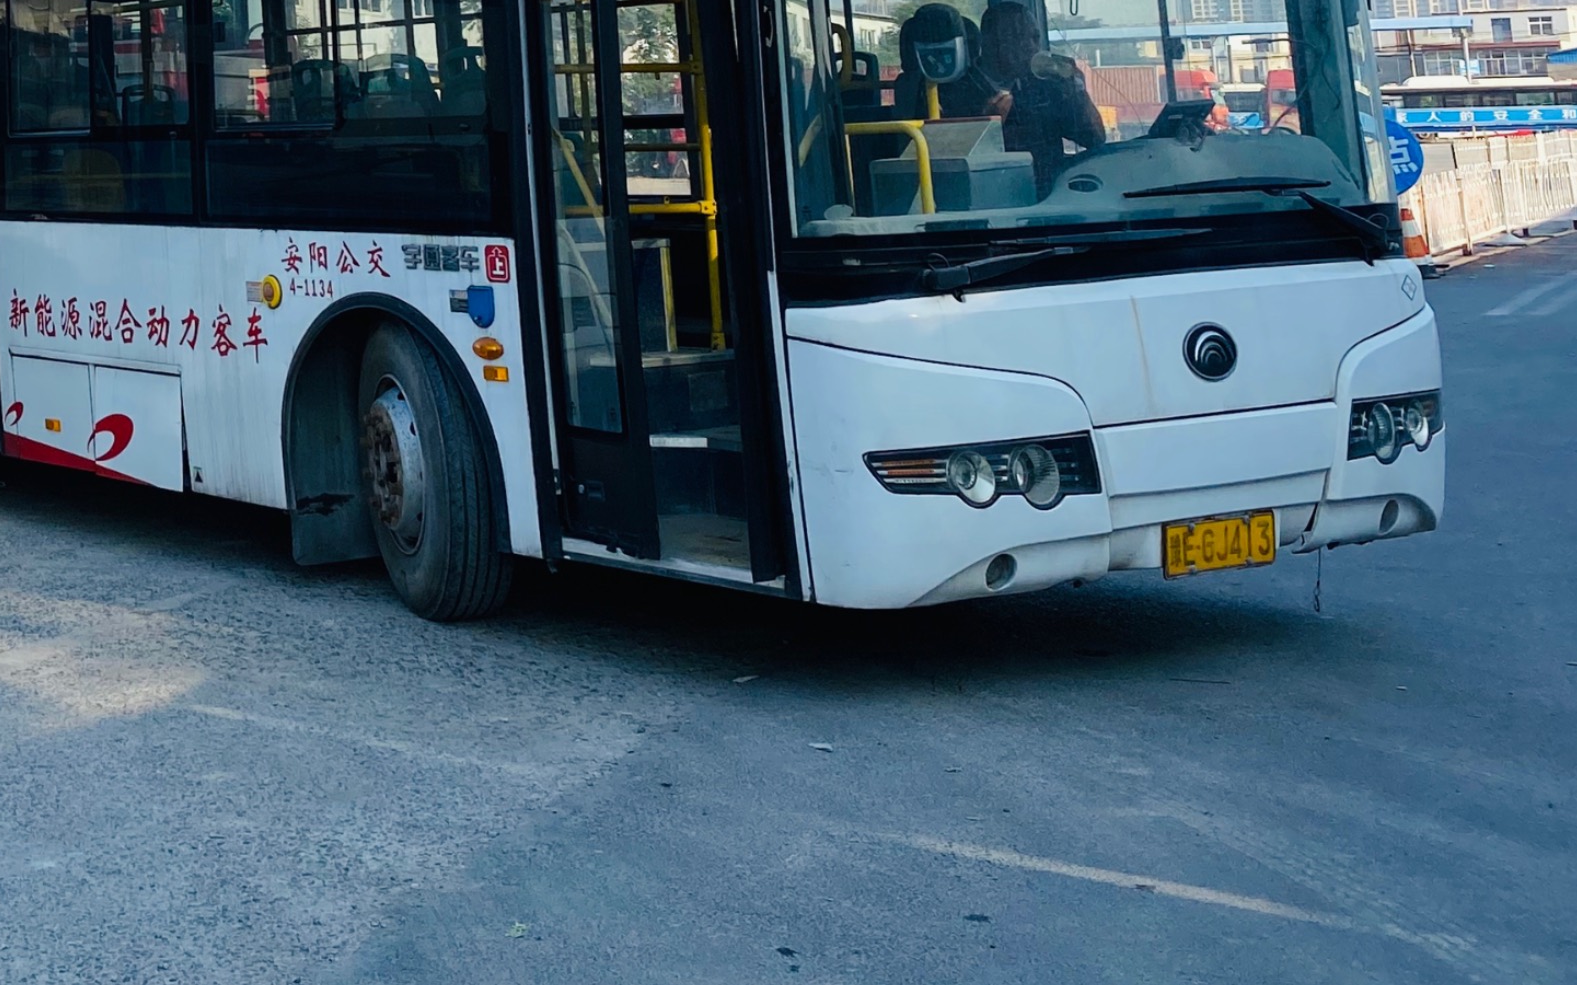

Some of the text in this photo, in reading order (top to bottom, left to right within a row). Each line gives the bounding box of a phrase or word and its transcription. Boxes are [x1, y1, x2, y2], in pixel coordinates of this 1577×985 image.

[281, 236, 391, 278] 安阳公交
[492, 257, 505, 275] 上
[289, 277, 334, 297] 4-1134
[8, 288, 269, 364] 新能源混合动力客车
